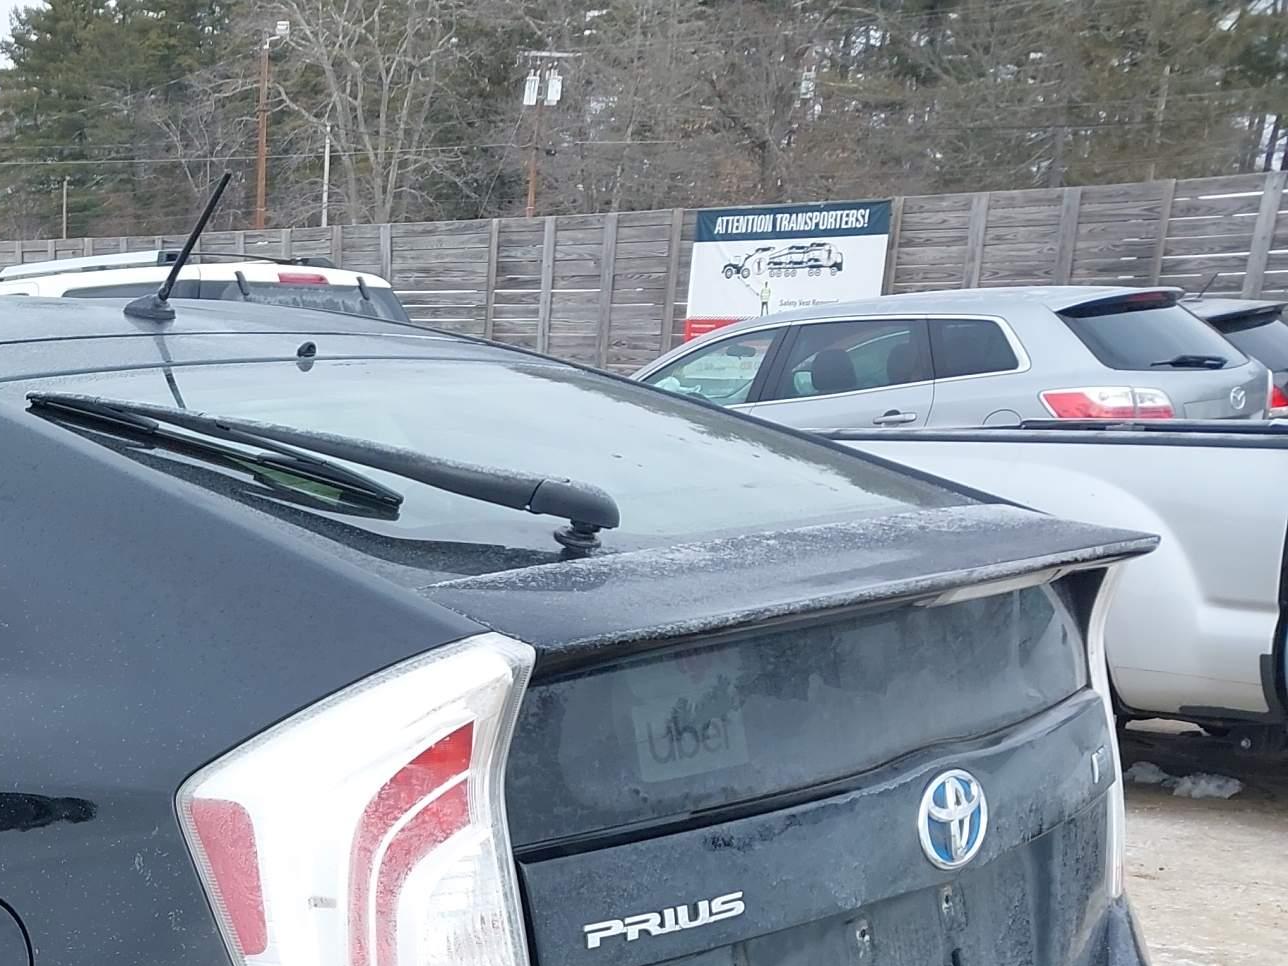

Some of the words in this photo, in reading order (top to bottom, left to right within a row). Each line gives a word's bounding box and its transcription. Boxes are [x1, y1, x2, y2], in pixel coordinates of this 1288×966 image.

[714, 214, 773, 234] ATTENTION
[776, 208, 870, 231] TRANSPORTERS!
[646, 713, 731, 765] Uber
[582, 890, 746, 950] PRIUS
